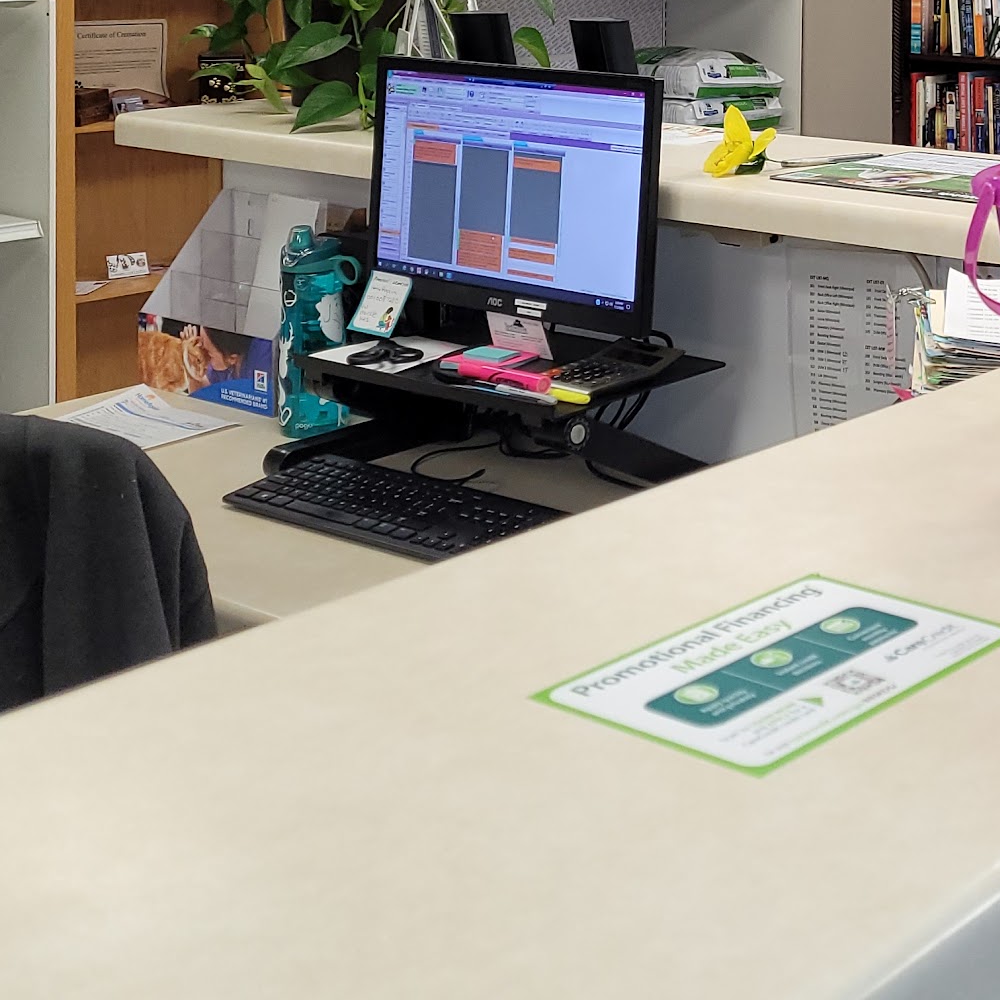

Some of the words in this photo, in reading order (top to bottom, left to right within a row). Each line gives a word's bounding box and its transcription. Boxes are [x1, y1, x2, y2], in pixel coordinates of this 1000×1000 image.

[487, 297, 502, 306] AOC
[571, 630, 717, 697] Promotional
[713, 585, 822, 633] Financing
[671, 640, 743, 673] Made
[737, 618, 793, 646] Easy
